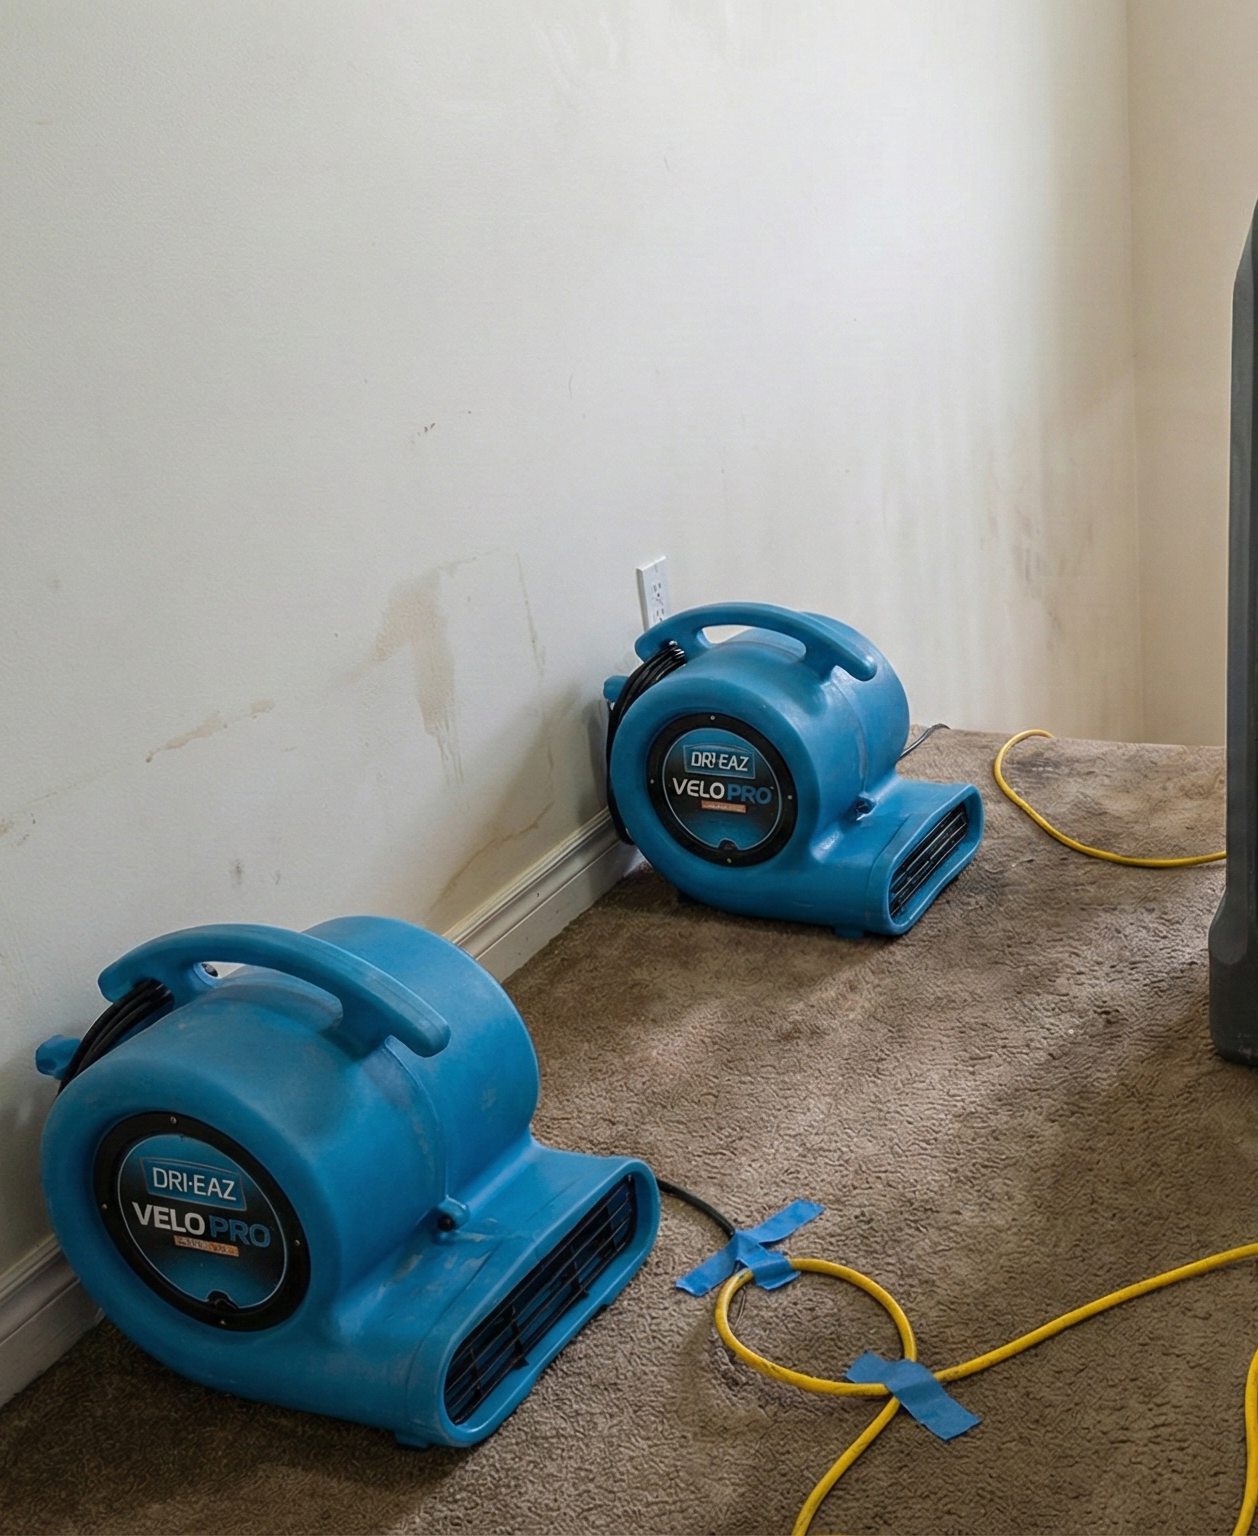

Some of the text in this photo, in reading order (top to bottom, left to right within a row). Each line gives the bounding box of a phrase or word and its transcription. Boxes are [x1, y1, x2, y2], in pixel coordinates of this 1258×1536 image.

[672, 777, 772, 805] VELO PRO
[131, 1201, 206, 1236] VELO
[208, 1214, 272, 1249] PRO
